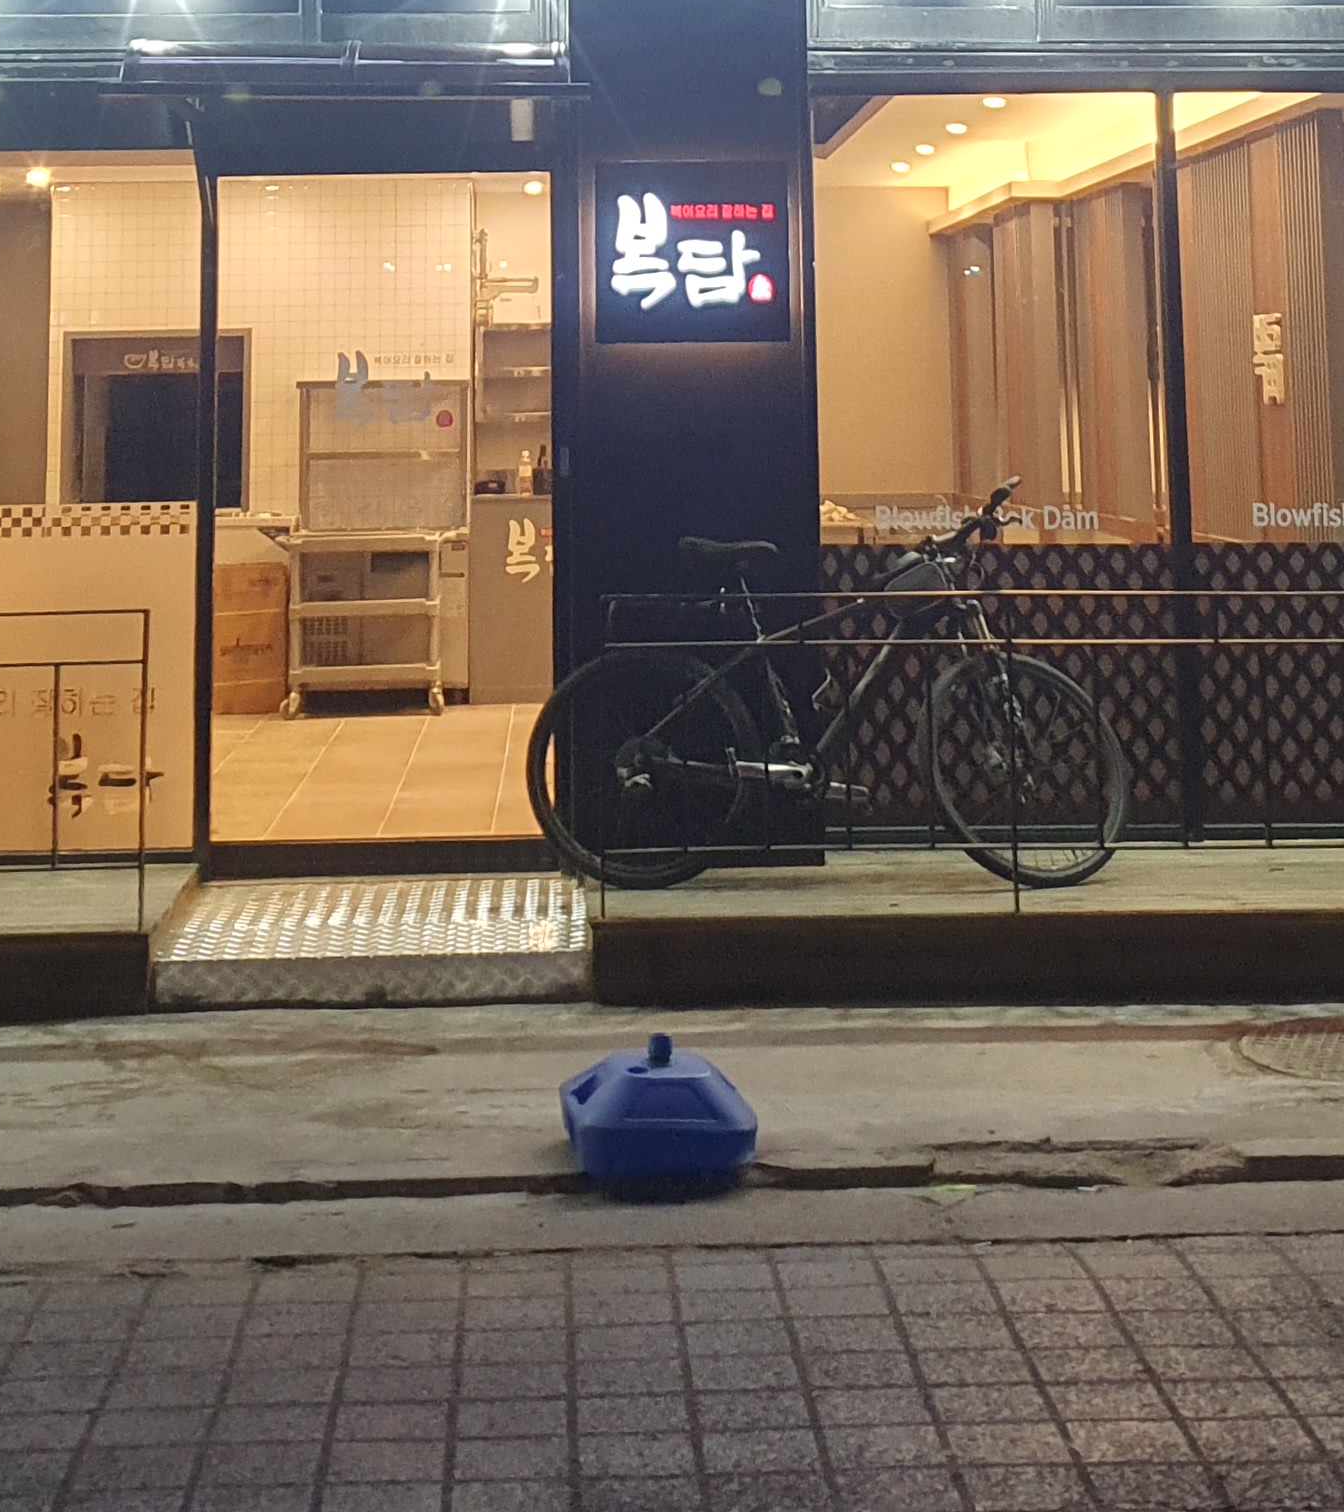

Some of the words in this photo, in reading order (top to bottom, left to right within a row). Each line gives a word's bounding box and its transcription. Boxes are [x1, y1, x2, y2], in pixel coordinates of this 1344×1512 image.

[611, 192, 761, 311] 복담
[506, 517, 553, 583] 복
[875, 505, 977, 530] Blowfish
[1043, 506, 1099, 531] Dam
